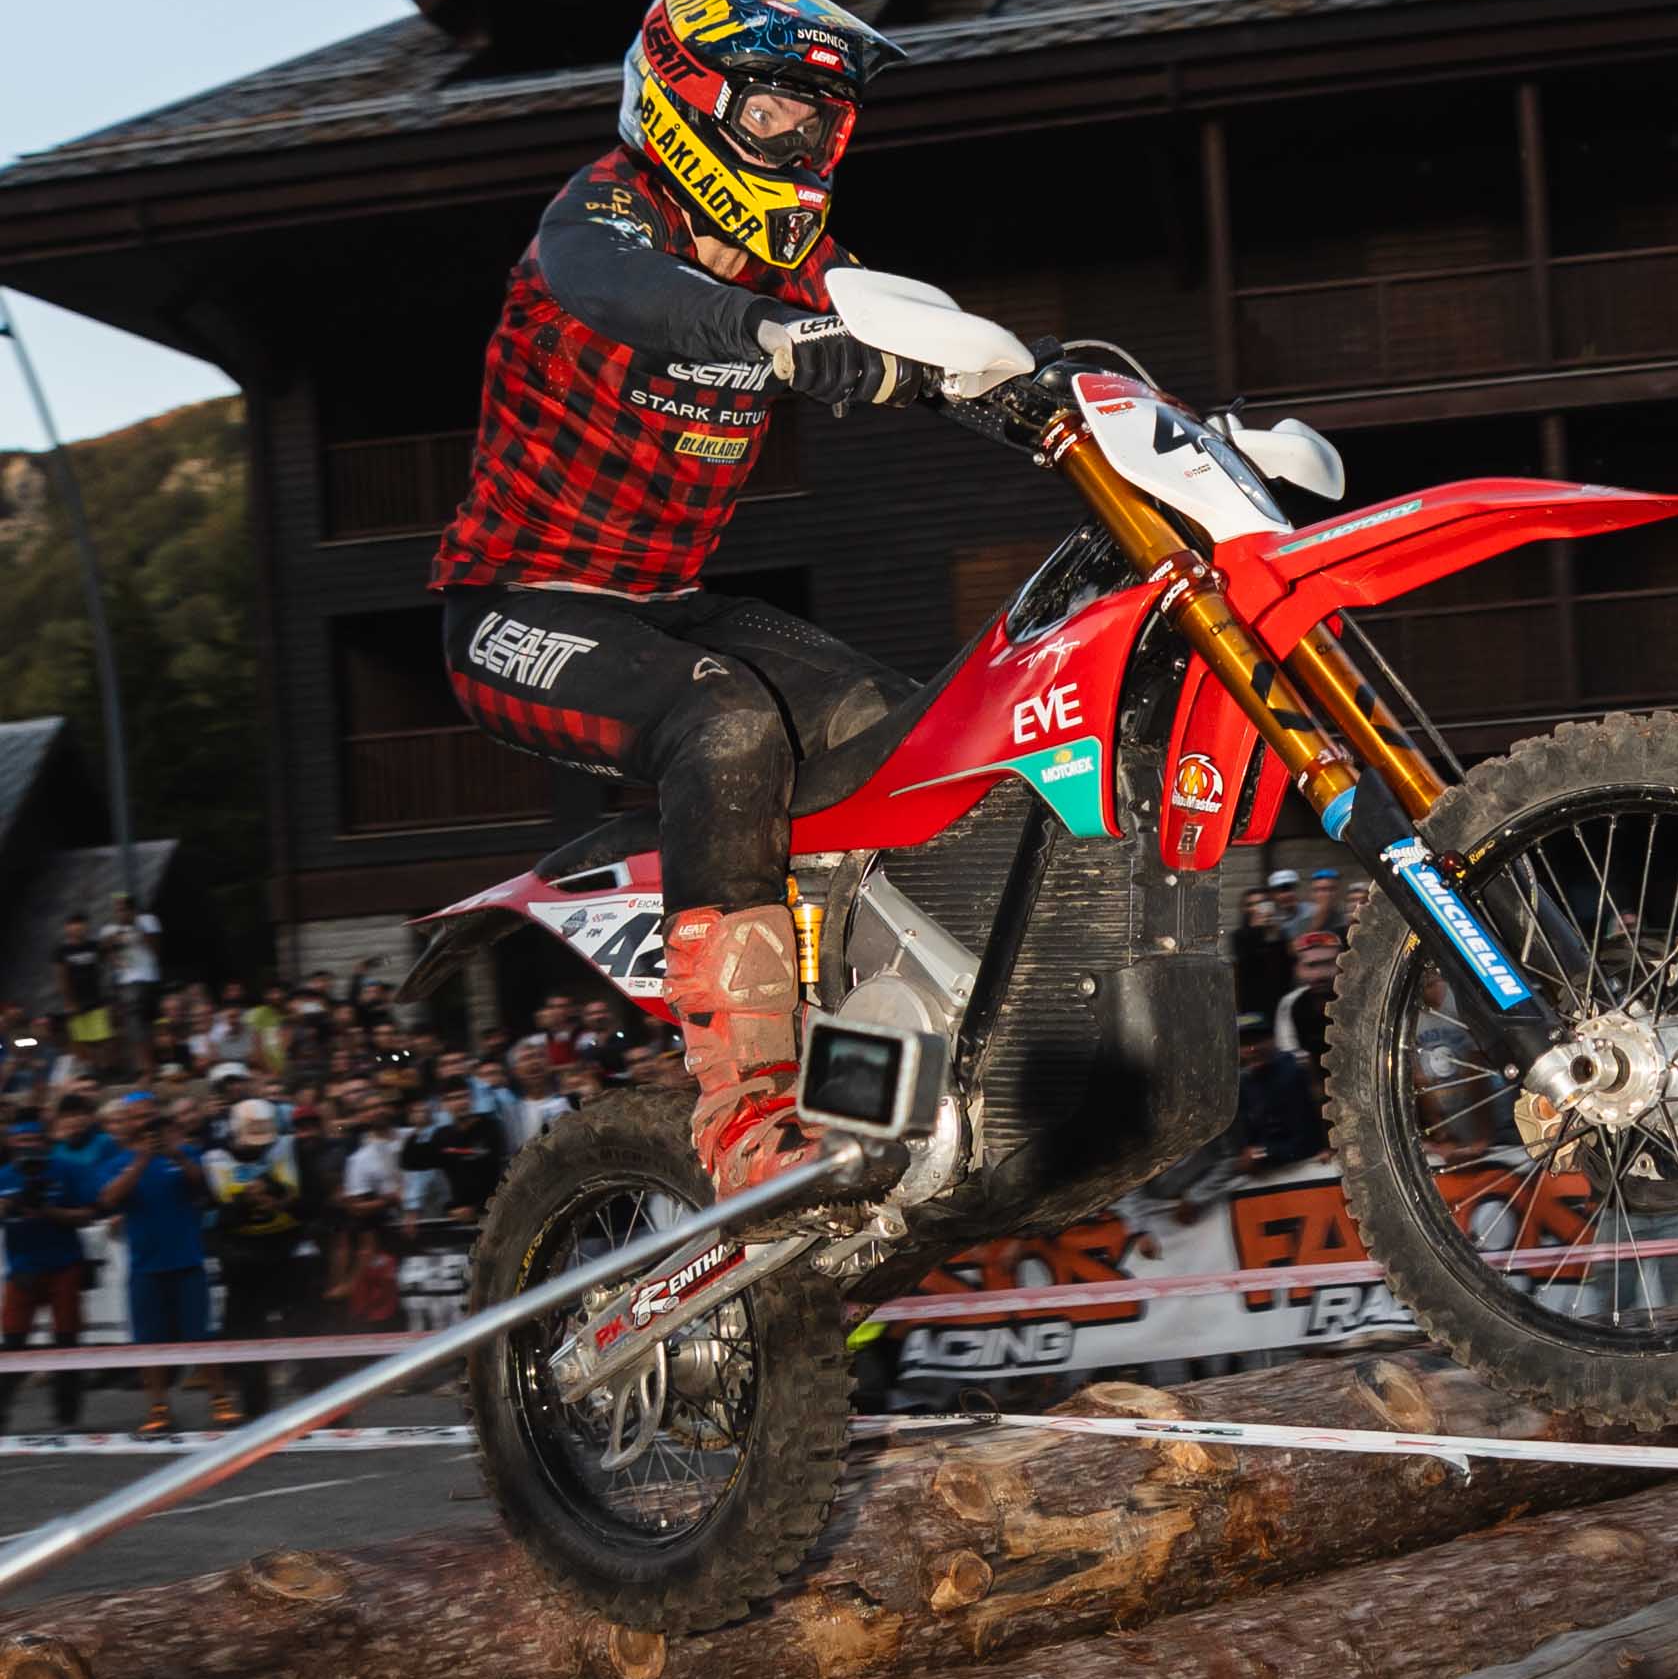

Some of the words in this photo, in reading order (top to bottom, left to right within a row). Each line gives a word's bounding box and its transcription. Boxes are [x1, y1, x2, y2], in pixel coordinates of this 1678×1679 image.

[645, 13, 707, 84] LEATT
[797, 28, 849, 53] SVEDNECK
[811, 48, 840, 66] LEATT
[713, 79, 733, 119] LEATT
[640, 95, 764, 243] BLÅKLÄDER
[630, 389, 711, 421] STARK
[679, 435, 747, 458] BLÅKLÄDER
[469, 611, 600, 690] LEATT
[1013, 682, 1083, 744] EVE
[1041, 757, 1095, 784] MOTOREX
[678, 923, 711, 936] LEATT
[1416, 871, 1524, 996] MICHELIN
[631, 1244, 726, 1328] RENTHA
